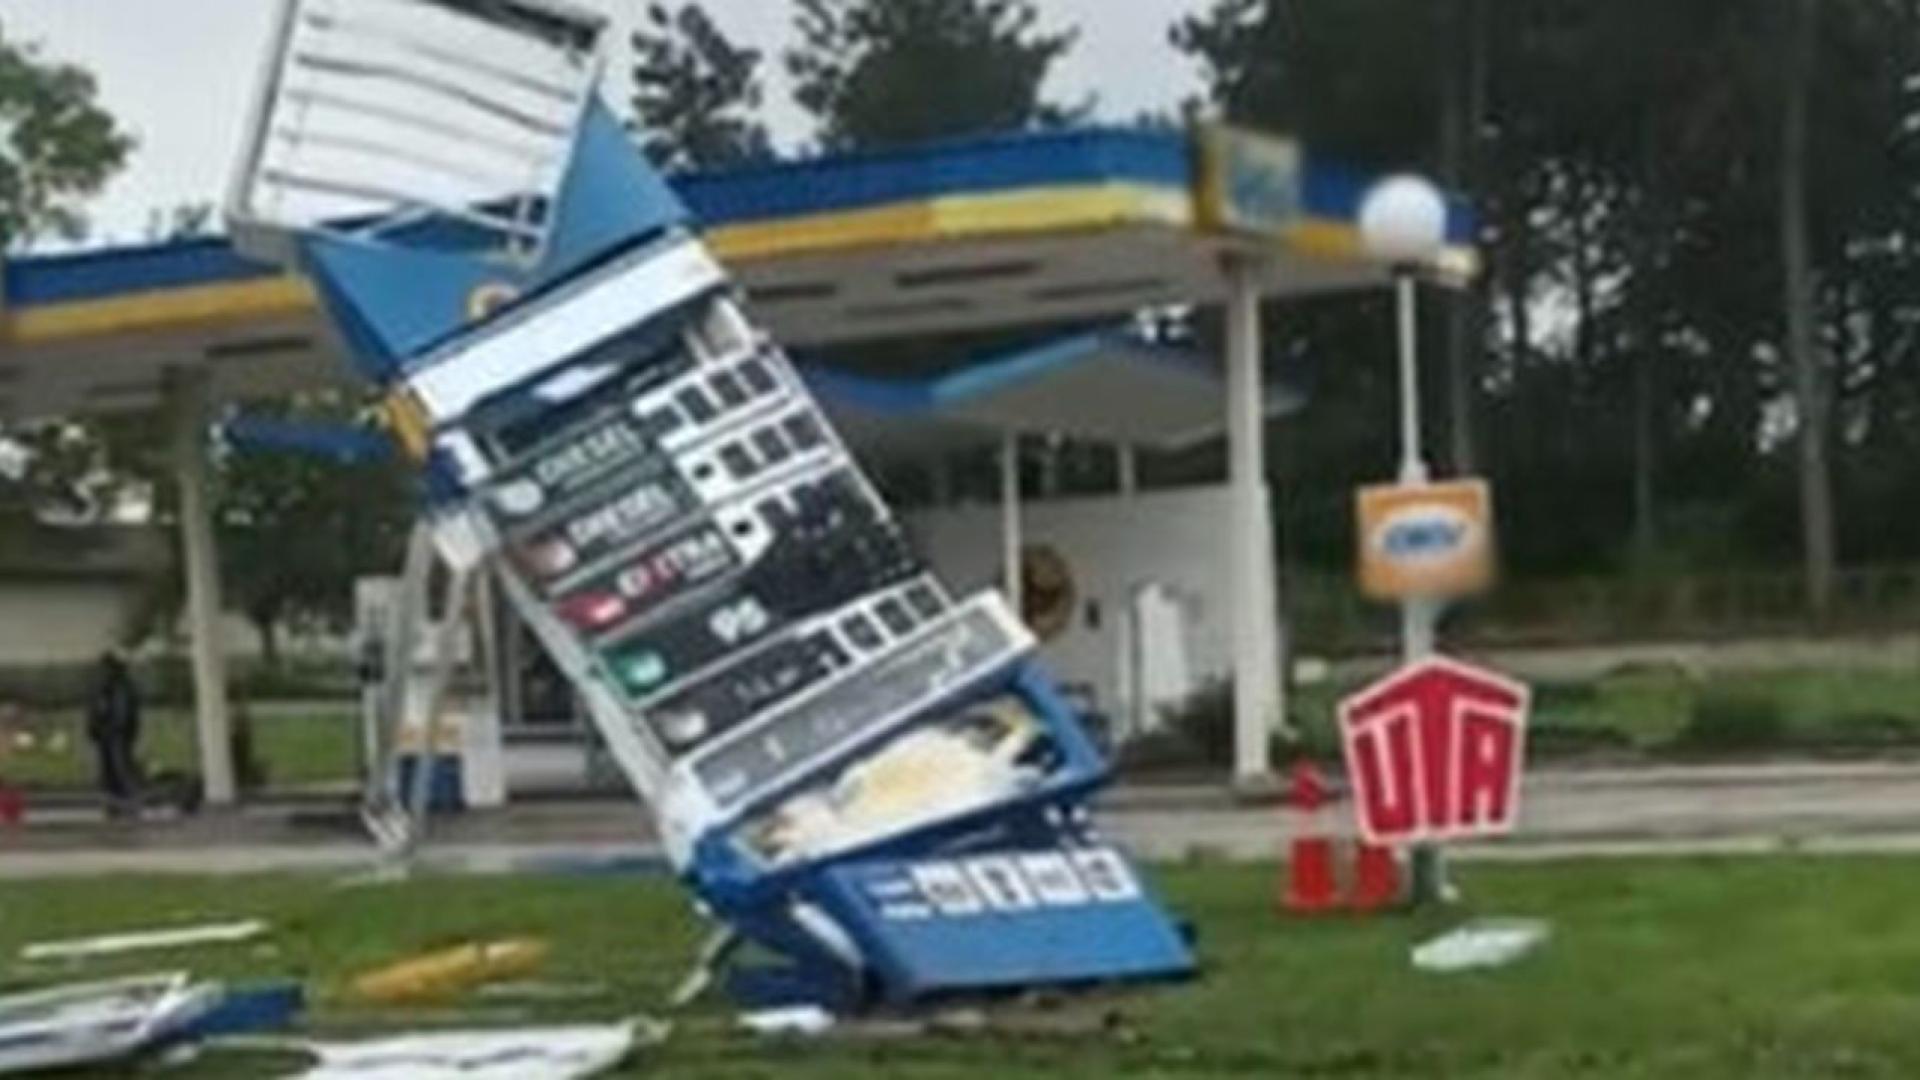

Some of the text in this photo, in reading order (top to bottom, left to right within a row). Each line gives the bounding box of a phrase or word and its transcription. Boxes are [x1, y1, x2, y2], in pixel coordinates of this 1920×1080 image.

[537, 421, 646, 484] DIESEL
[568, 485, 679, 547] DIESEL
[708, 595, 770, 645] 95
[1346, 664, 1522, 834] UTA
